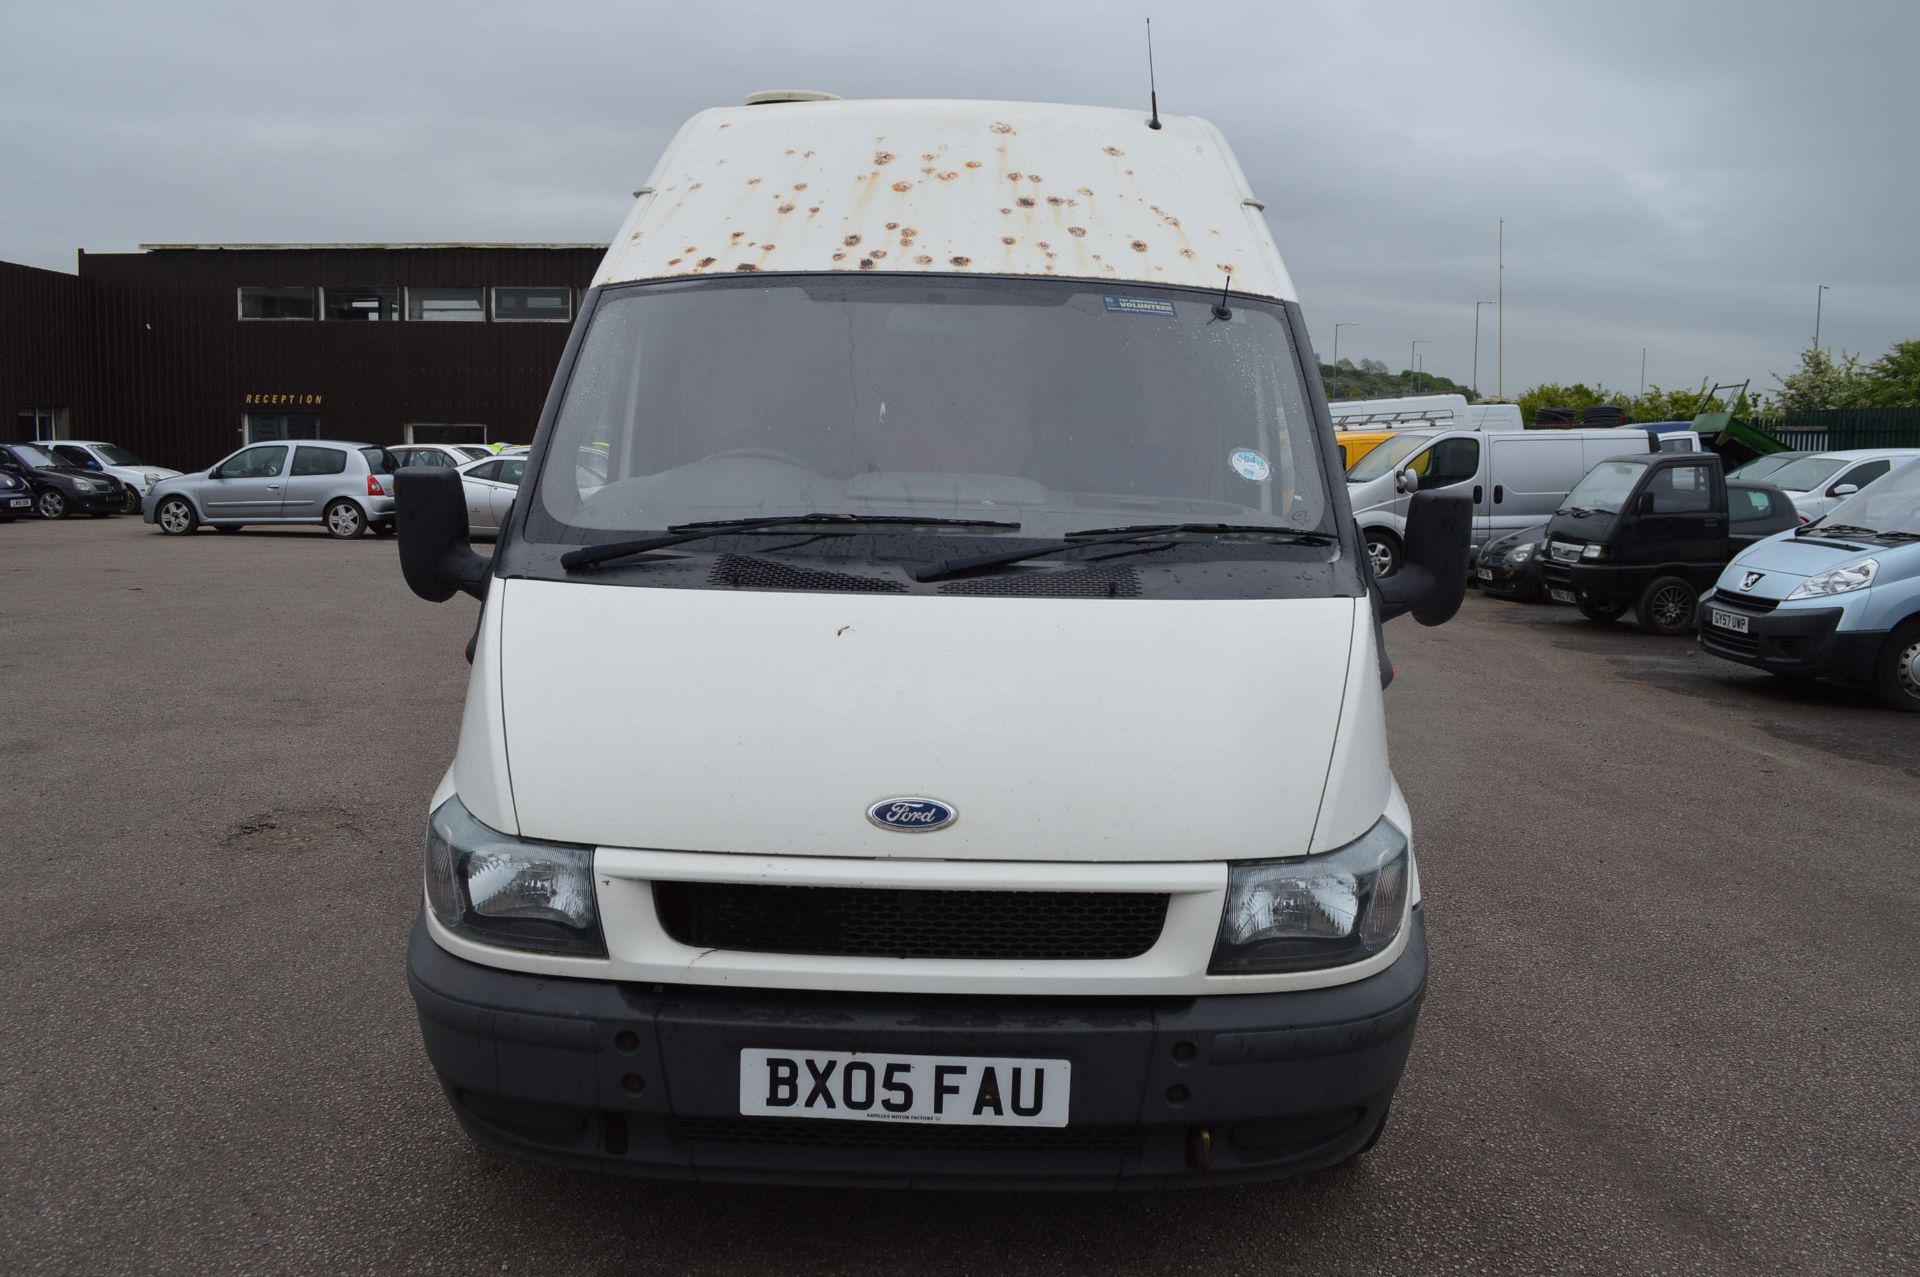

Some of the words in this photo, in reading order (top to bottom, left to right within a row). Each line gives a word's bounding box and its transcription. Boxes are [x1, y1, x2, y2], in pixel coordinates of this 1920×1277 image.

[1119, 302, 1173, 312] VOLUNTEER
[246, 394, 322, 404] RECEPTION
[1714, 611, 1731, 628] GY57
[1731, 615, 1746, 630] UWP
[886, 802, 937, 822] Ford
[766, 1058, 914, 1112] BX05
[934, 1065, 1045, 1117] FAU
